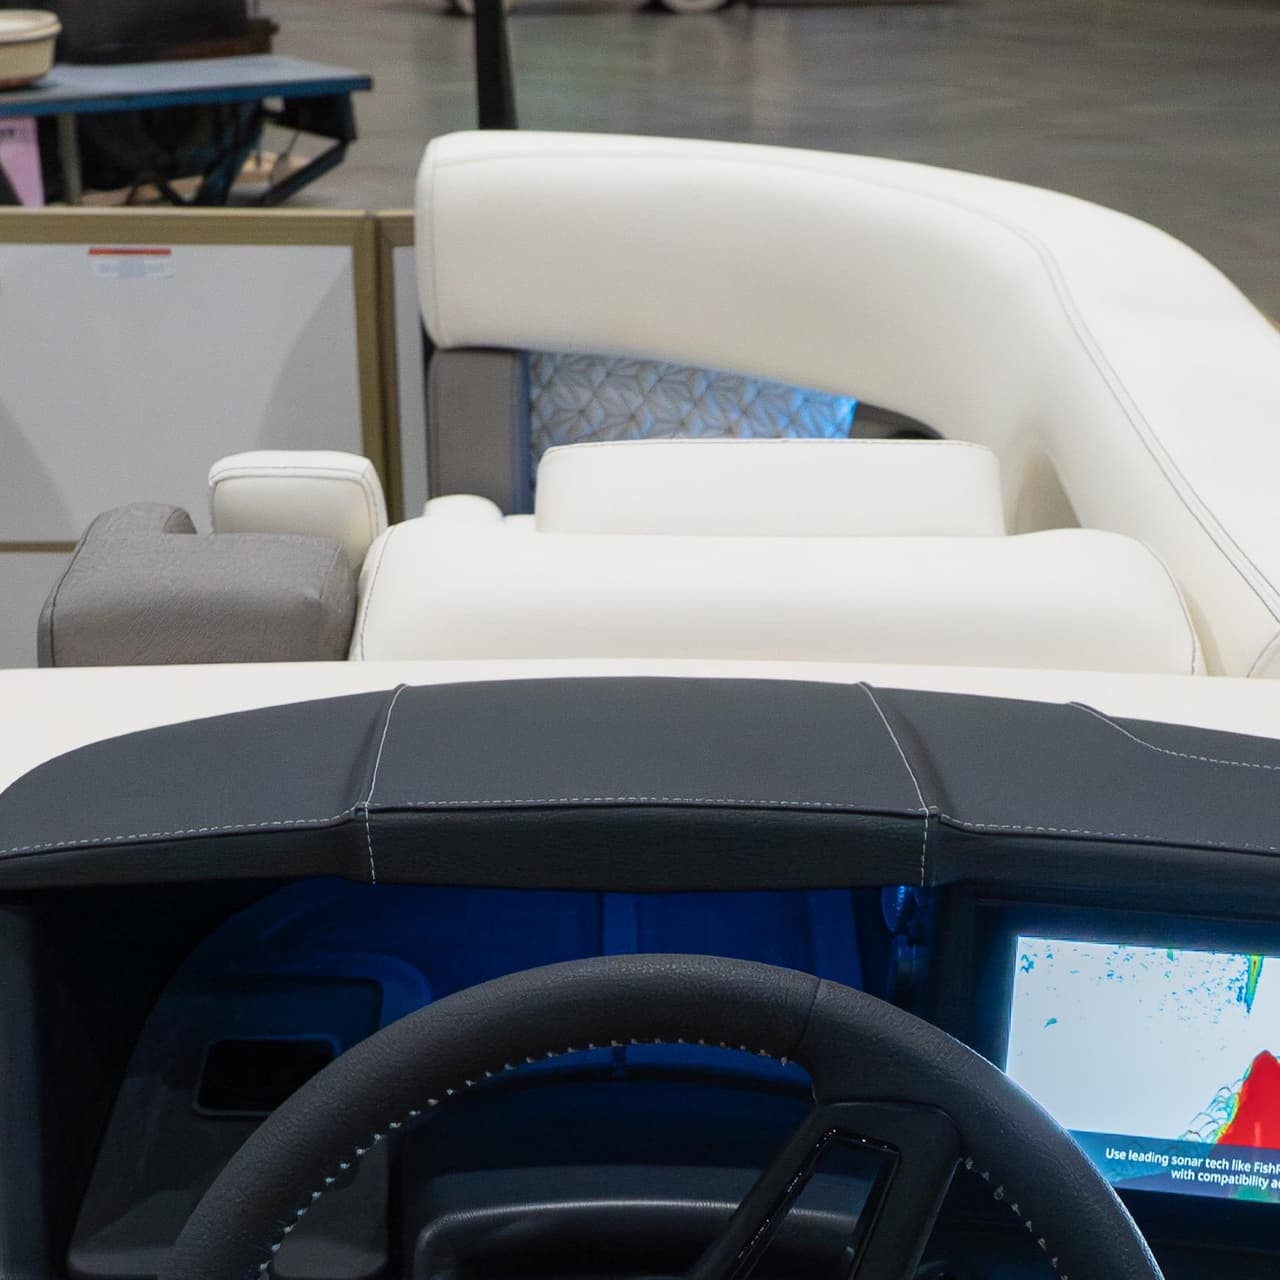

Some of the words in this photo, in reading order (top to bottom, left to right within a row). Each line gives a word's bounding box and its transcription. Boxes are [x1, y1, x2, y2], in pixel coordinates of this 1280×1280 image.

[1105, 1147, 1127, 1161] Use
[1128, 1150, 1169, 1166] leading
[1171, 1155, 1203, 1168] sonar
[1205, 1157, 1230, 1171] tech
[1231, 1159, 1251, 1173] like
[1171, 1169, 1196, 1181] with
[1197, 1171, 1270, 1190] compatibility
